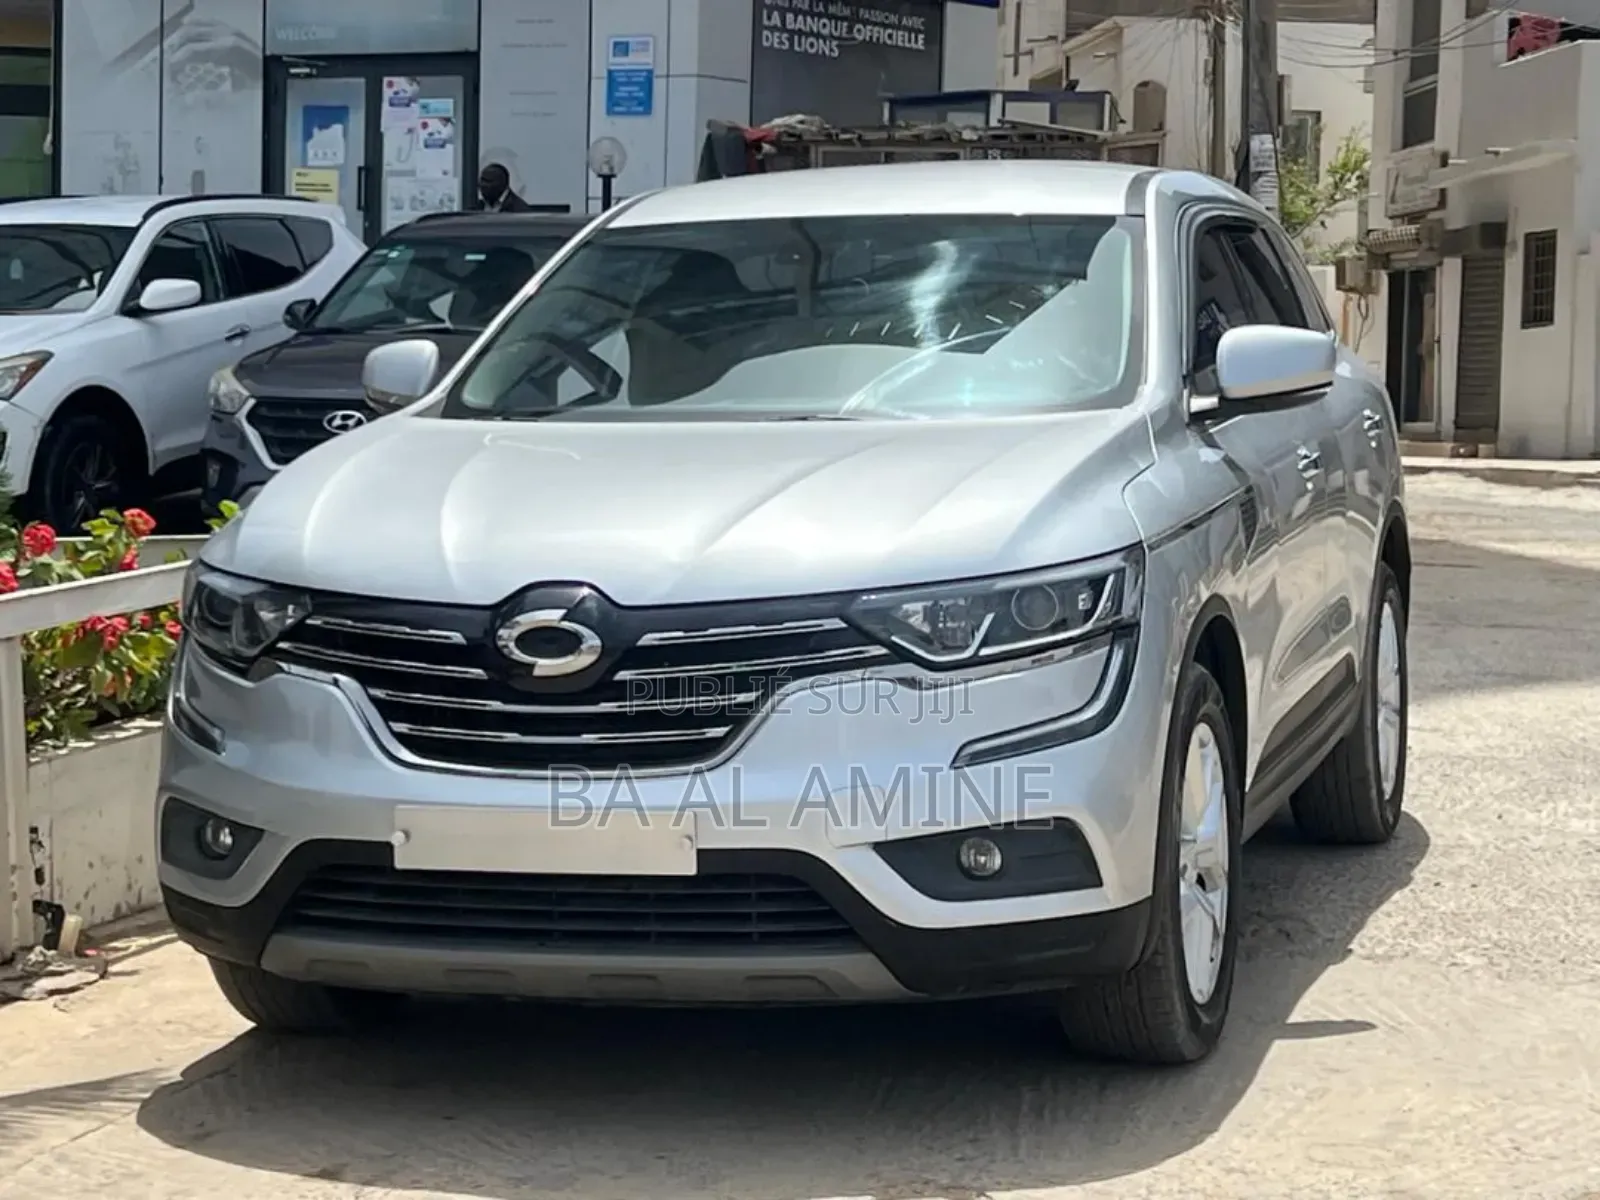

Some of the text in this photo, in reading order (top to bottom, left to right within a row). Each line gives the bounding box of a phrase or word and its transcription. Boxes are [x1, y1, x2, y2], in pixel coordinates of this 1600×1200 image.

[762, 9, 925, 50] LA BANQUE OFFICIELLE
[813, 1, 825, 13] LA
[859, 7, 899, 25] PASSION
[901, 15, 925, 30] AVEC
[762, 30, 840, 58] DES LIONS
